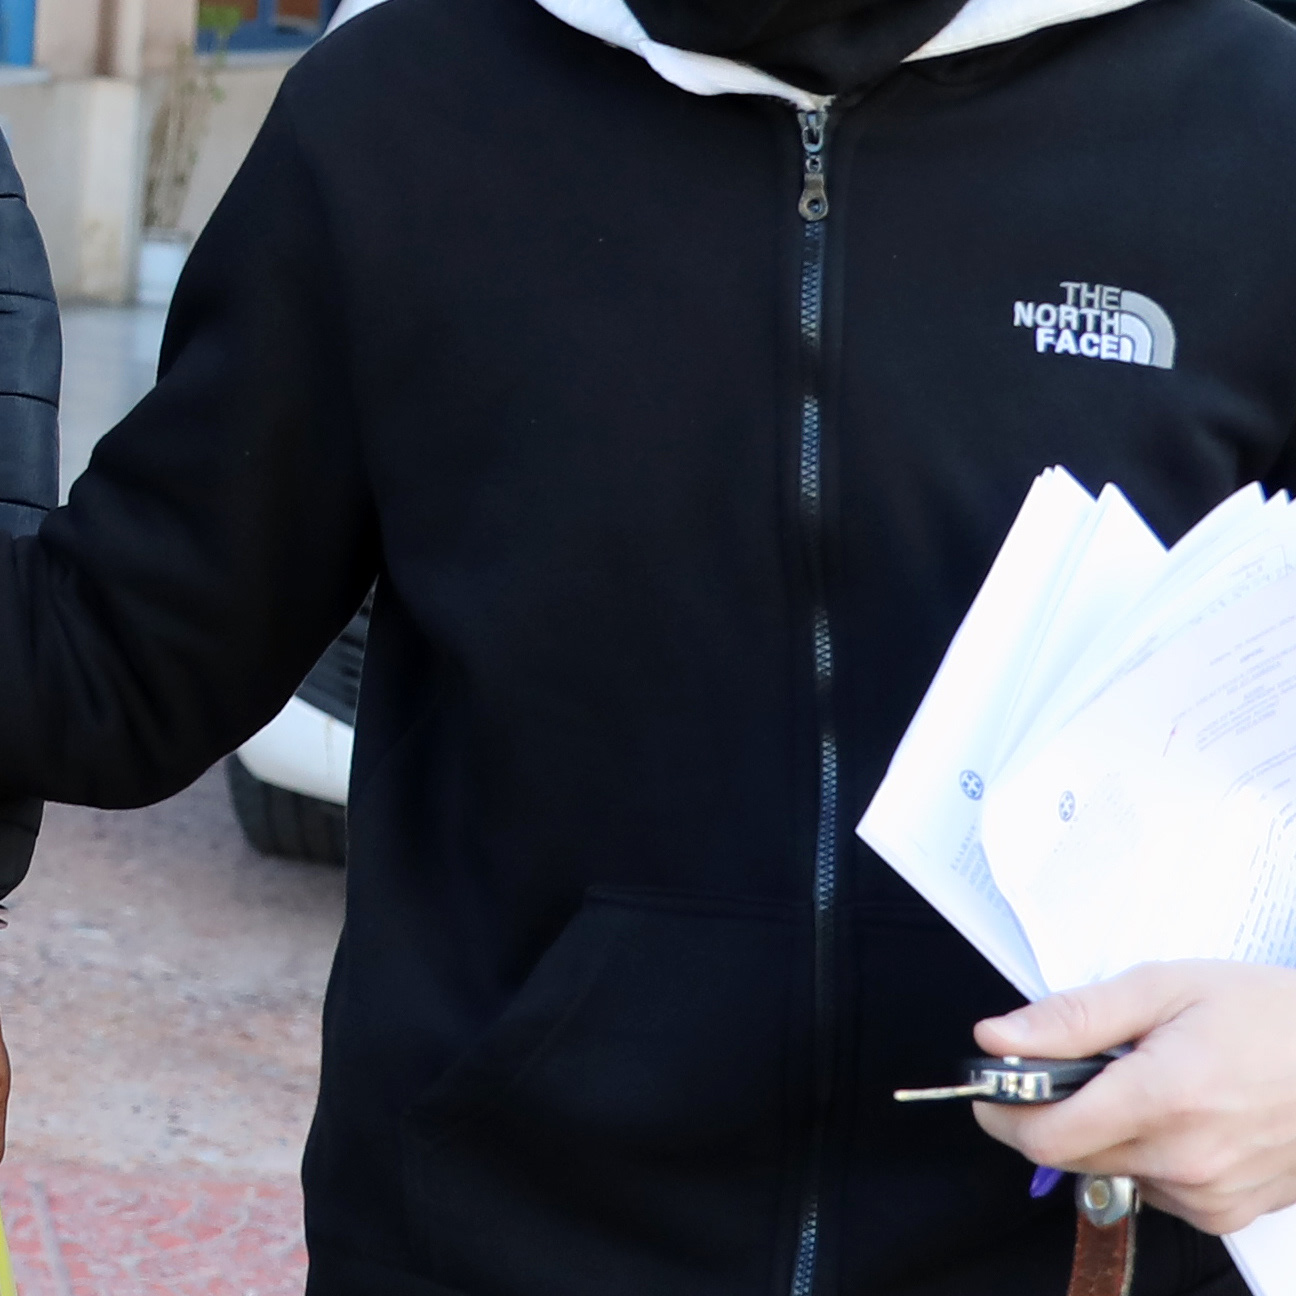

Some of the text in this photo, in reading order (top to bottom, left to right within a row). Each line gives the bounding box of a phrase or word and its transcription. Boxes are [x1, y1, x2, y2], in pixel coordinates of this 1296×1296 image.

[1059, 281, 1121, 310] THE
[1013, 301, 1120, 335] NORTH
[1035, 326, 1119, 360] FACE
